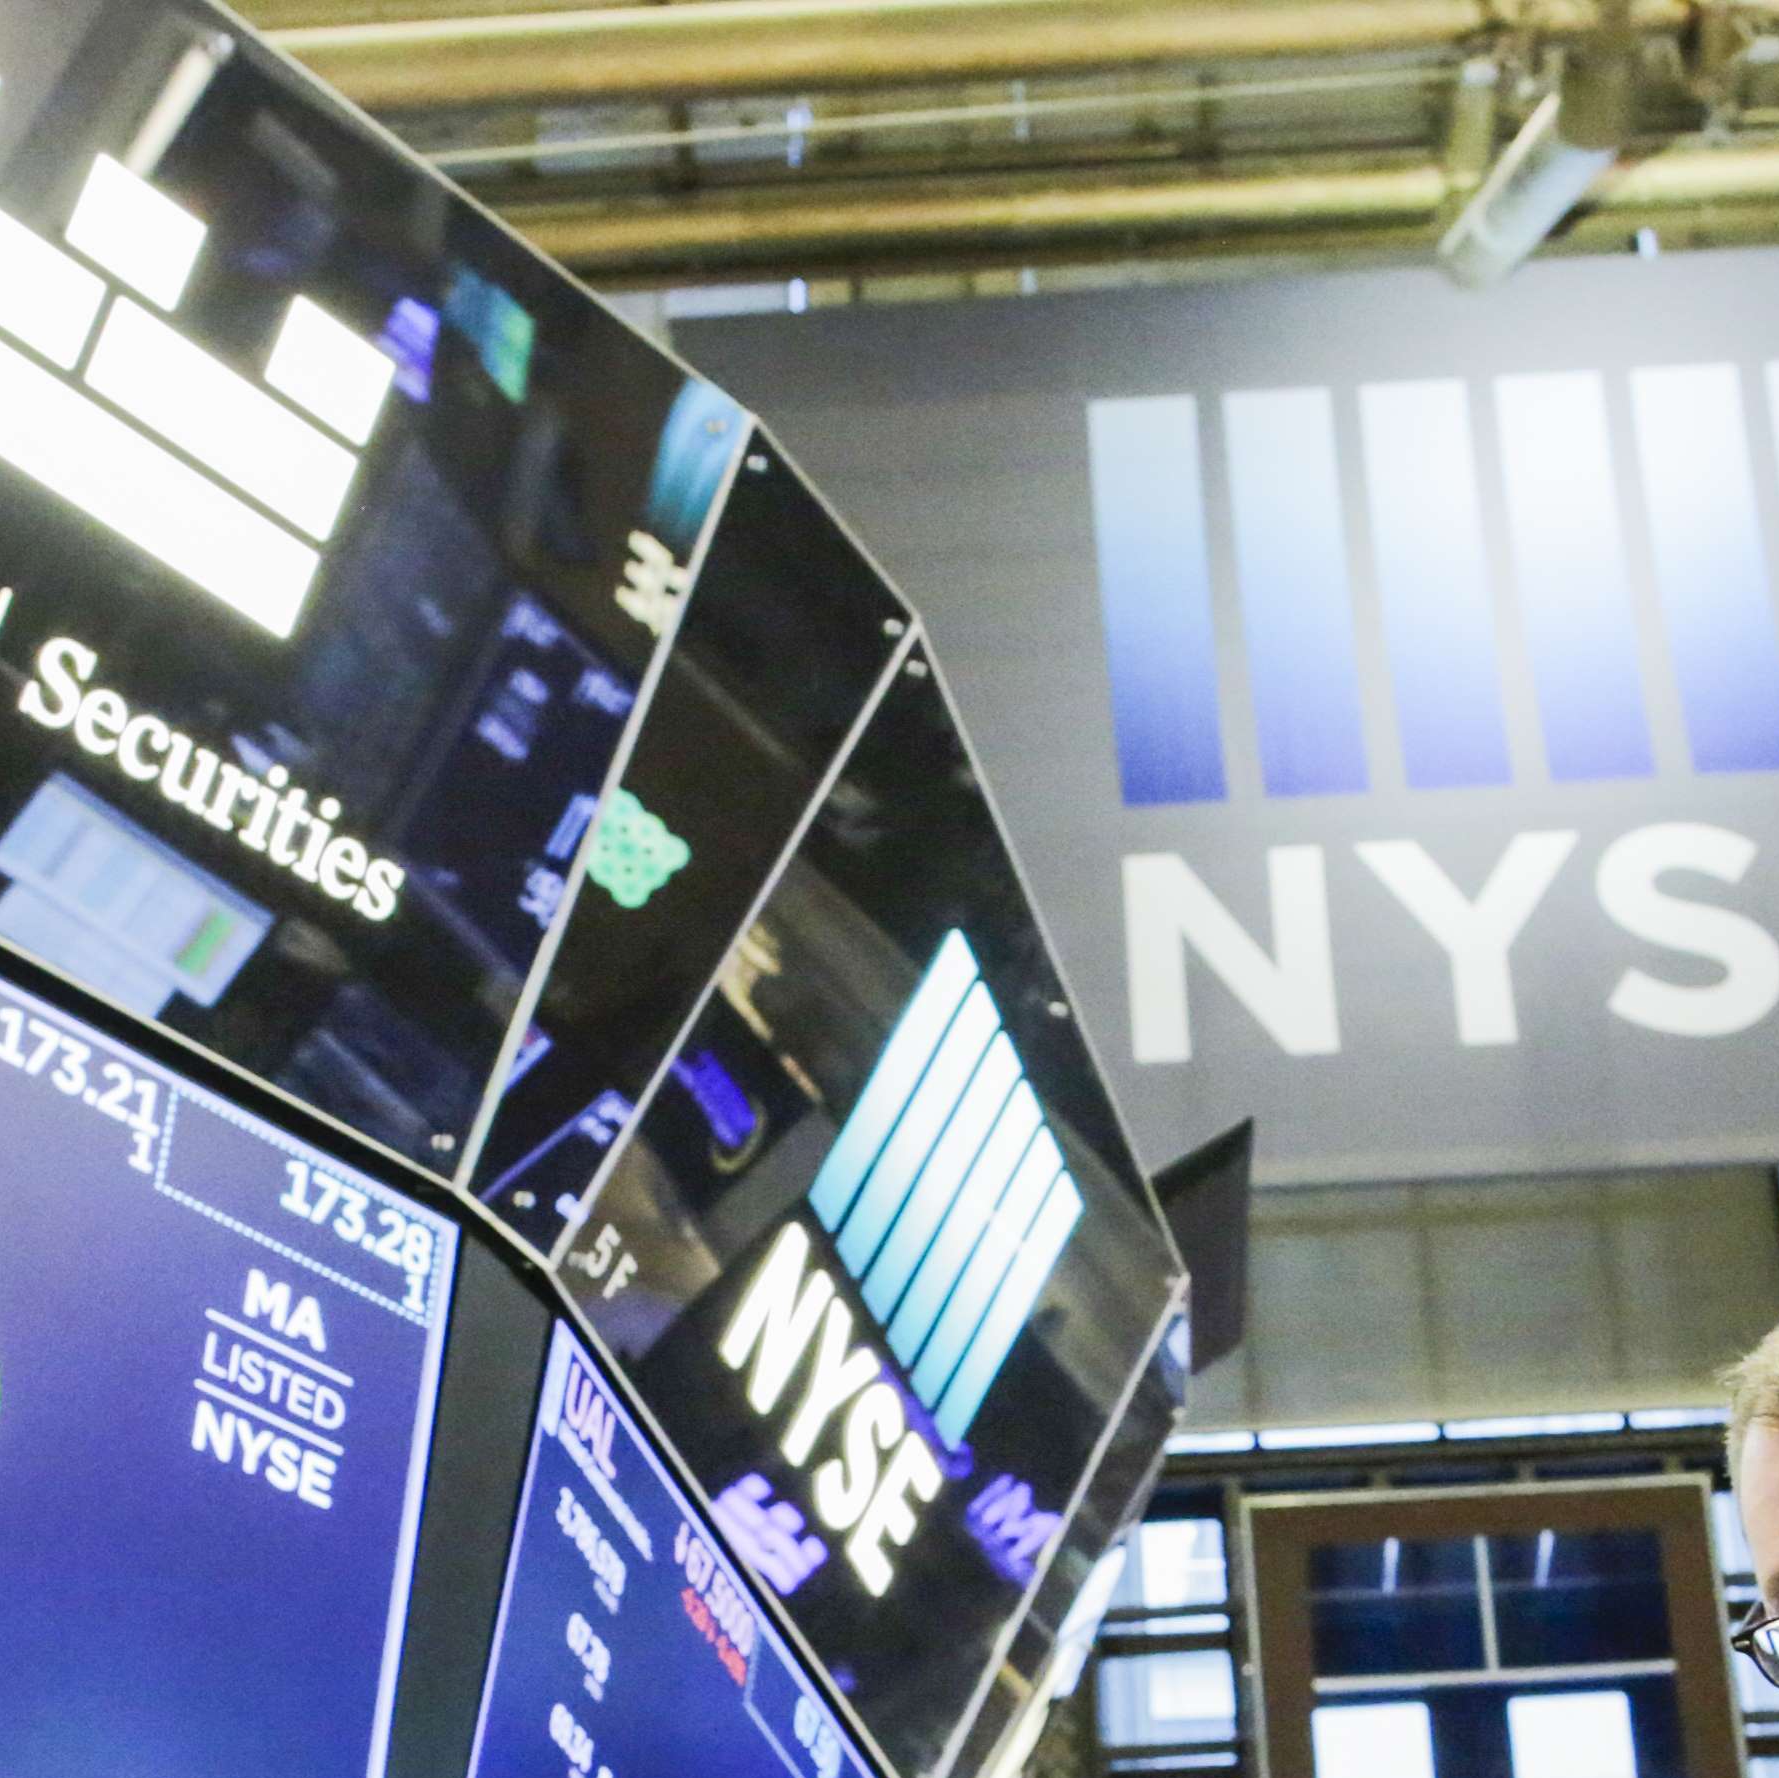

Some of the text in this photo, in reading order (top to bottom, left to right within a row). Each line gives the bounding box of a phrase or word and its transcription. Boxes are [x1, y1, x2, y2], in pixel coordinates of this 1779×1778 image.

[19, 636, 406, 922] Securities
[127, 1129, 155, 1175] 1
[278, 1159, 435, 1277] 173.28
[242, 1268, 327, 1353] MA
[201, 1331, 346, 1432] LISTED
[562, 1361, 618, 1480] UAL
[719, 1220, 944, 1598] NYSE
[190, 1400, 338, 1511] NYSE
